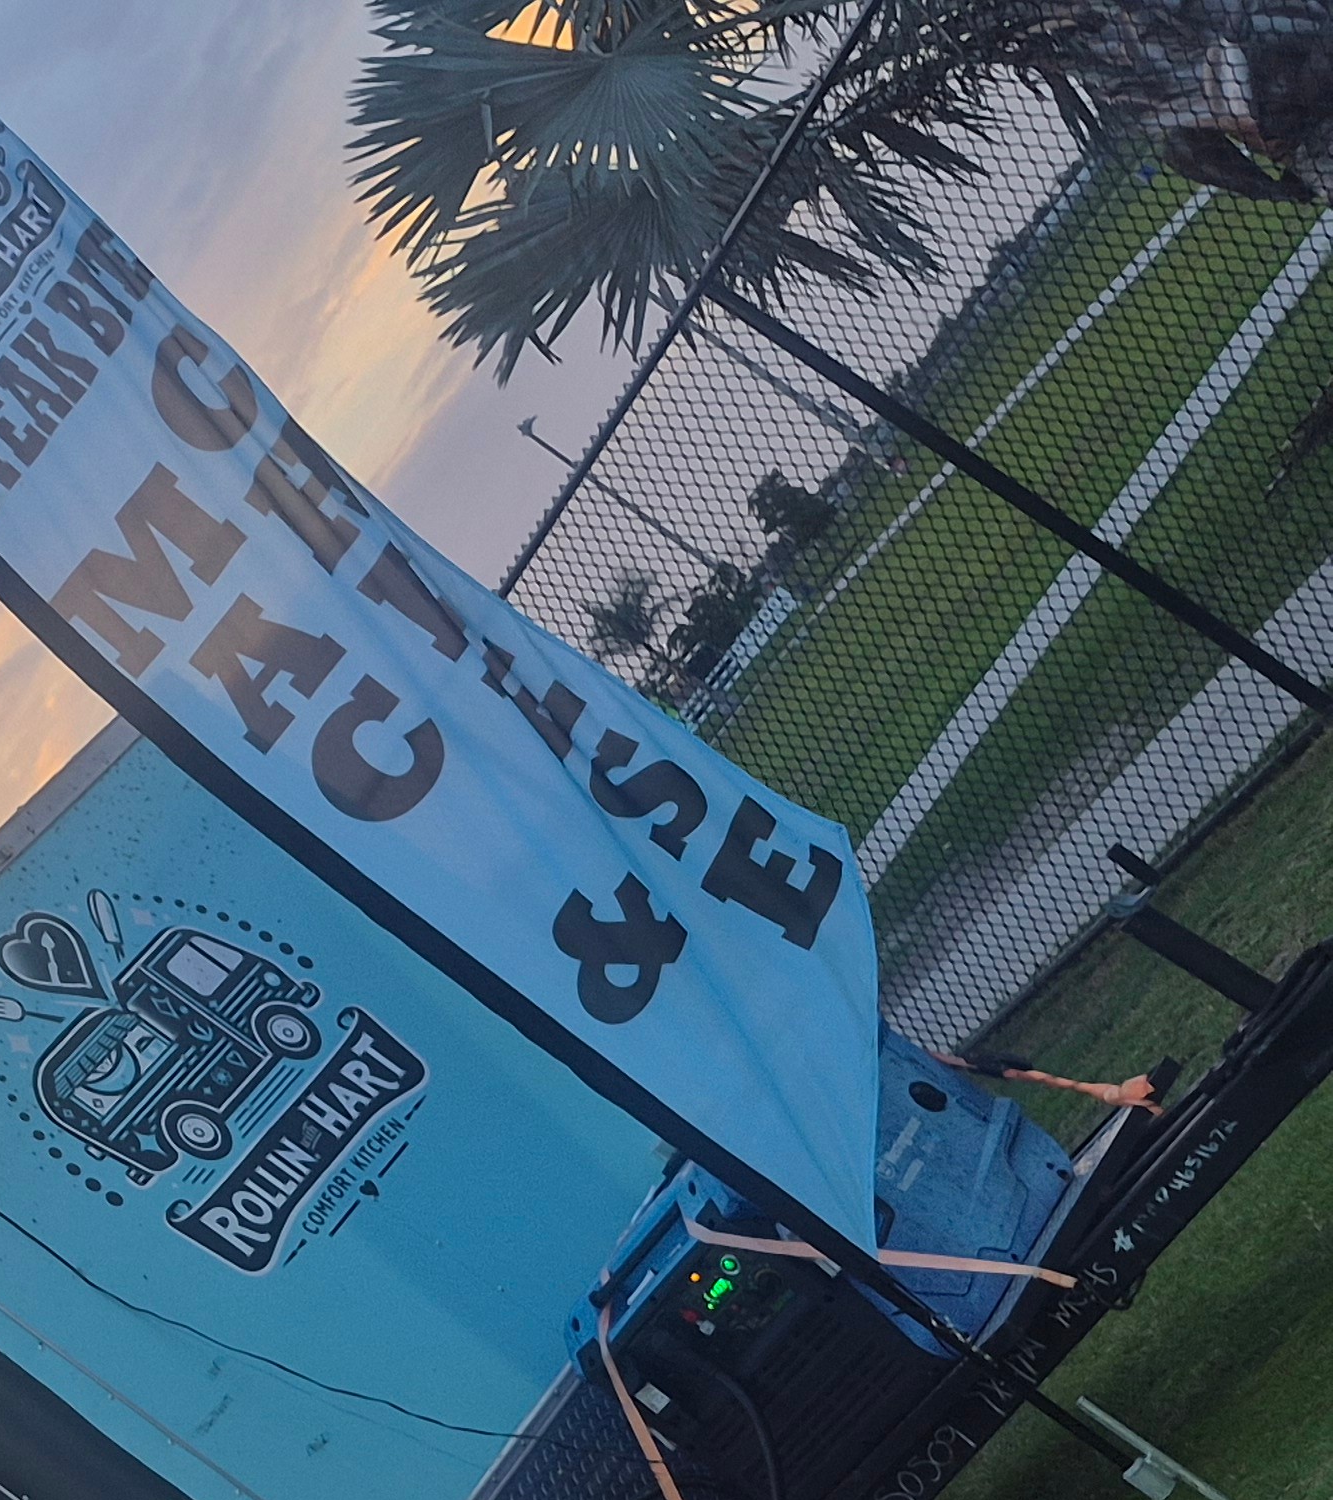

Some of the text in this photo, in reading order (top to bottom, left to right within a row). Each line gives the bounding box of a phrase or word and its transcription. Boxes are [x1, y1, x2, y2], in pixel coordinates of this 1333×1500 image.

[46, 462, 688, 1025] MAC &
[199, 1135, 321, 1258] ROLLIN
[298, 1032, 407, 1140] HART
[302, 1117, 406, 1236] COMFORT KITCHEN
